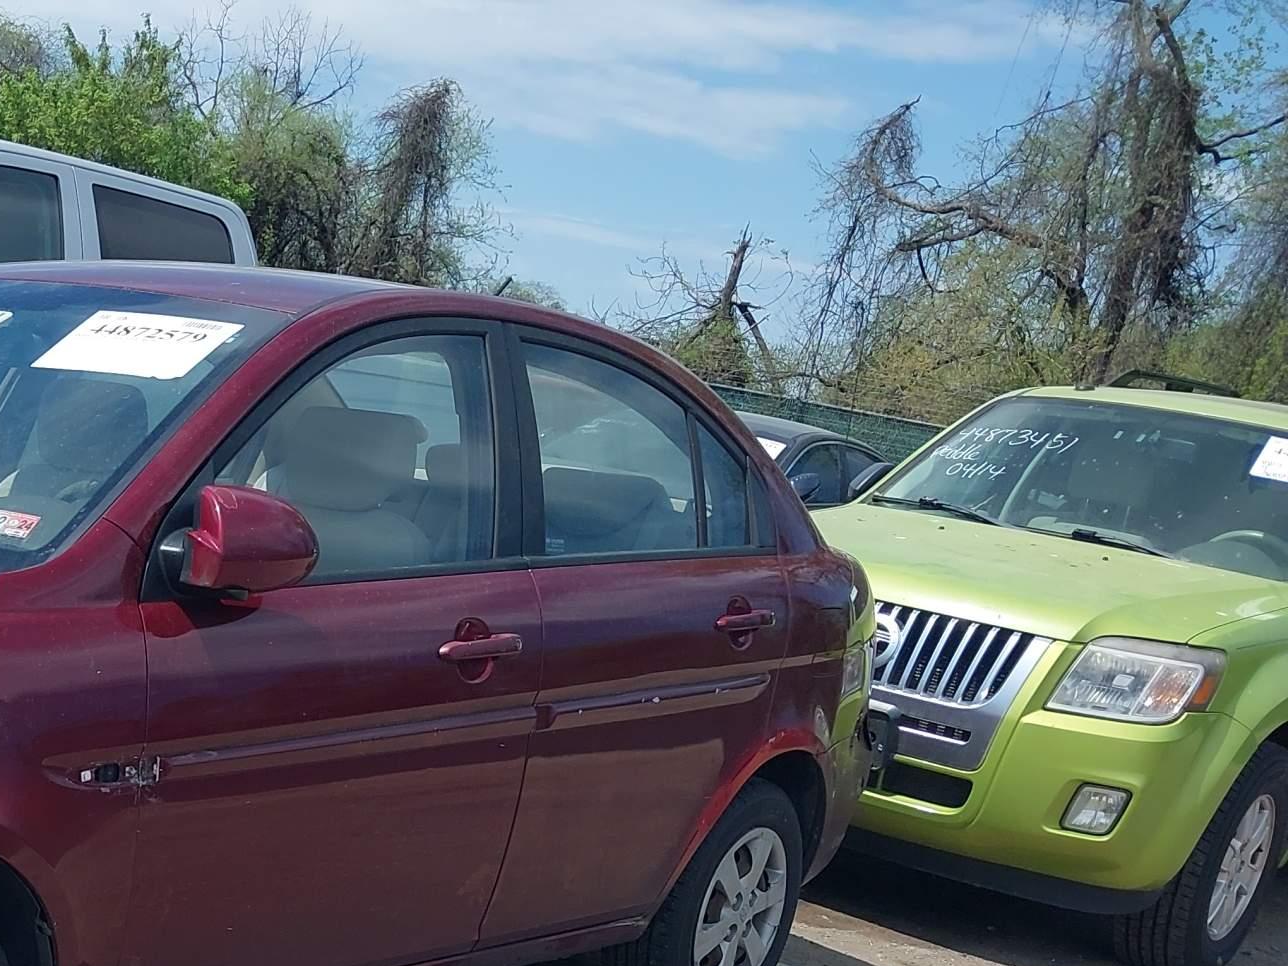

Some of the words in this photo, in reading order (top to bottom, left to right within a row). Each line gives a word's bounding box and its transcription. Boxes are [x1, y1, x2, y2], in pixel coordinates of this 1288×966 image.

[90, 323, 208, 343] 44872579
[959, 427, 1080, 454] 44873451
[17, 519, 35, 531] 24
